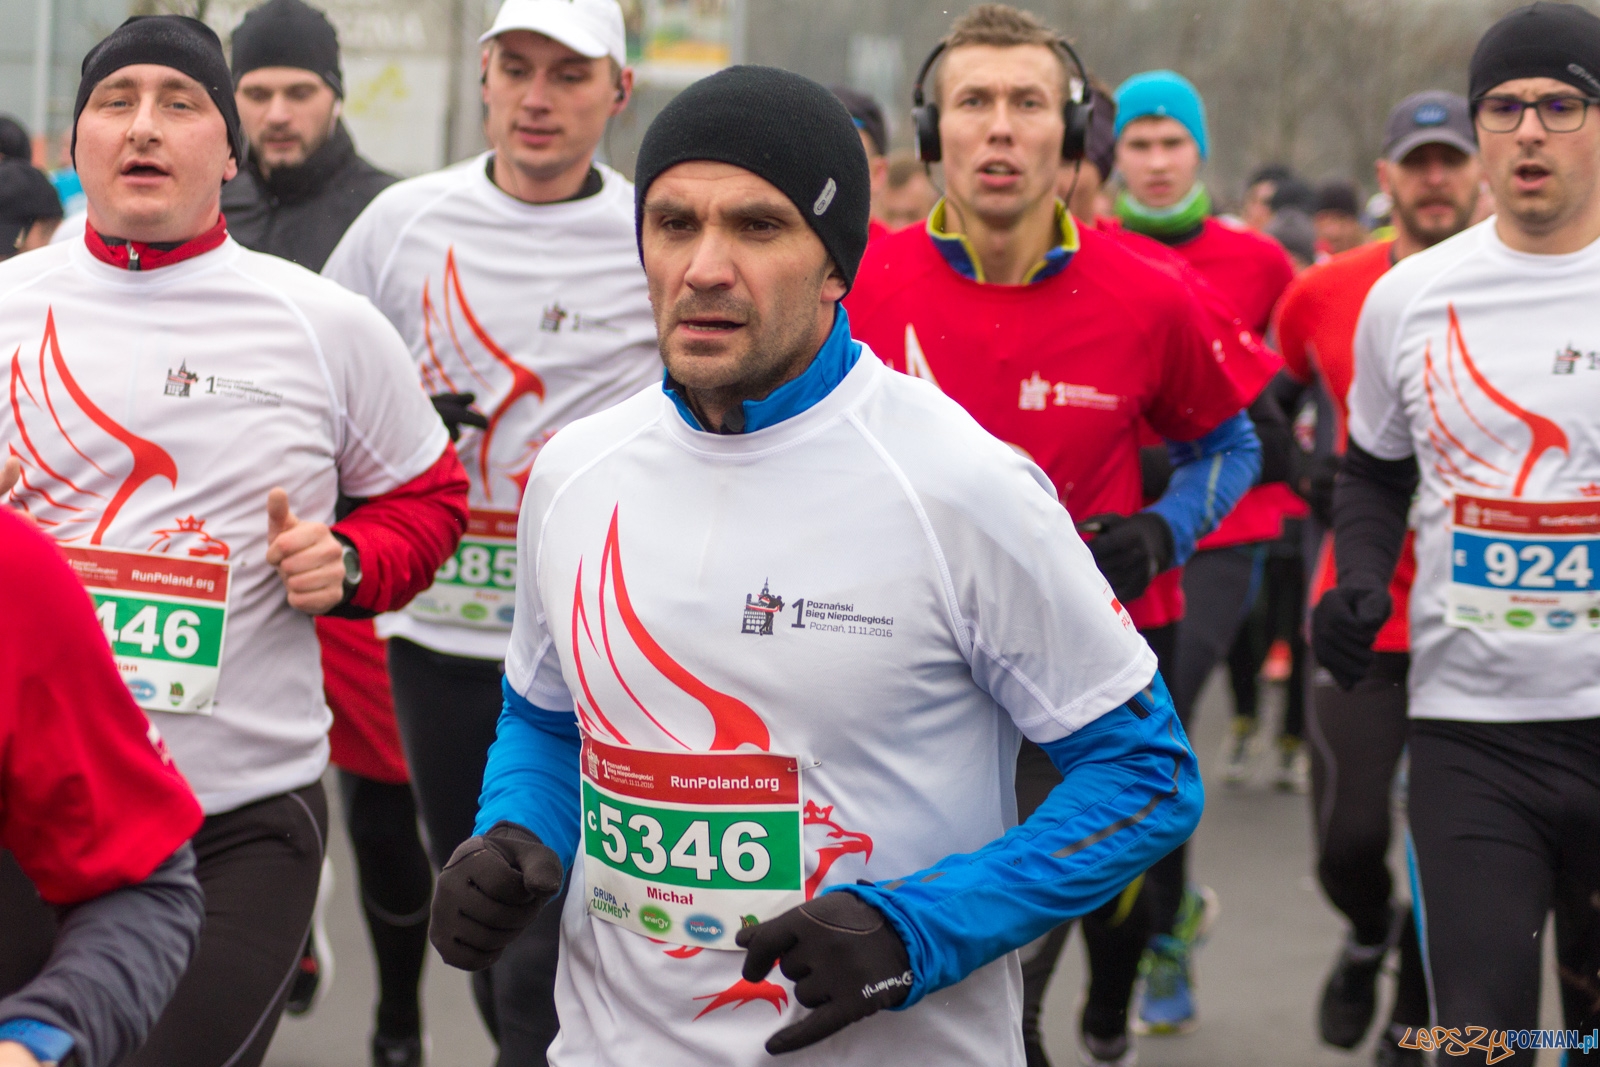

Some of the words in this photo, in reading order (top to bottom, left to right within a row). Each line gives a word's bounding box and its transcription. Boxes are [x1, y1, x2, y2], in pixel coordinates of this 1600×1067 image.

[205, 375, 217, 395] 1
[1454, 549, 1467, 567] E
[1483, 542, 1594, 588] 924
[131, 569, 215, 593] RunPoland.org
[791, 598, 806, 629] 1
[806, 600, 854, 612] Poznański
[805, 610, 825, 620] Bieg
[827, 611, 894, 626] Niepodległości
[96, 600, 201, 660] 446
[809, 621, 846, 633] Poznań,
[848, 625, 893, 638] 11.11.2016
[670, 775, 780, 792] RunPoland.org
[599, 801, 772, 883] 5346
[593, 886, 618, 907] GRUPA
[646, 886, 694, 906] Michał
[592, 898, 623, 919] LUXMED
